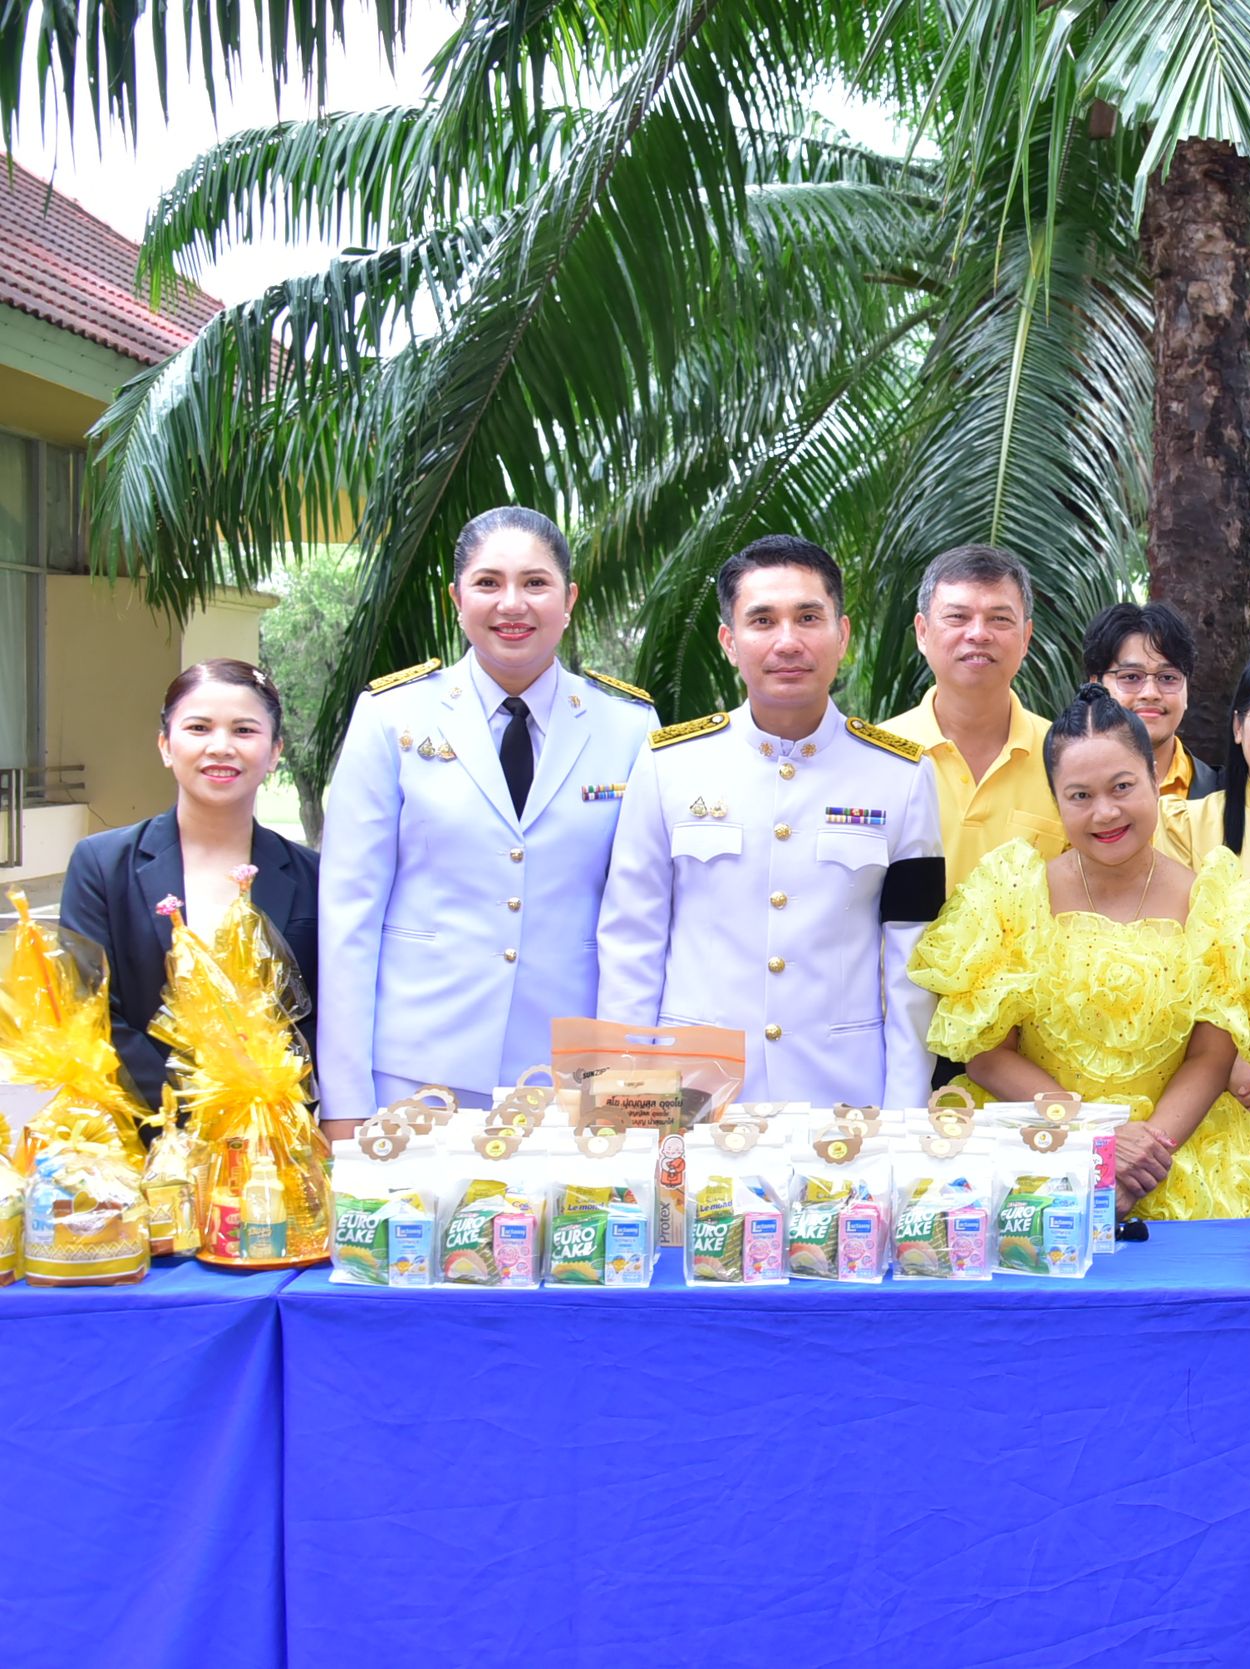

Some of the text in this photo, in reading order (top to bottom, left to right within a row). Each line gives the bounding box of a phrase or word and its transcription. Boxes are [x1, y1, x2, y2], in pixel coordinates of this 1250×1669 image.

[337, 1213, 381, 1229] EURO
[449, 1216, 487, 1234] EURO
[660, 1202, 671, 1244] Protex
[335, 1228, 376, 1244] CAKE
[446, 1229, 481, 1248] CAKE
[553, 1226, 596, 1247] EURO
